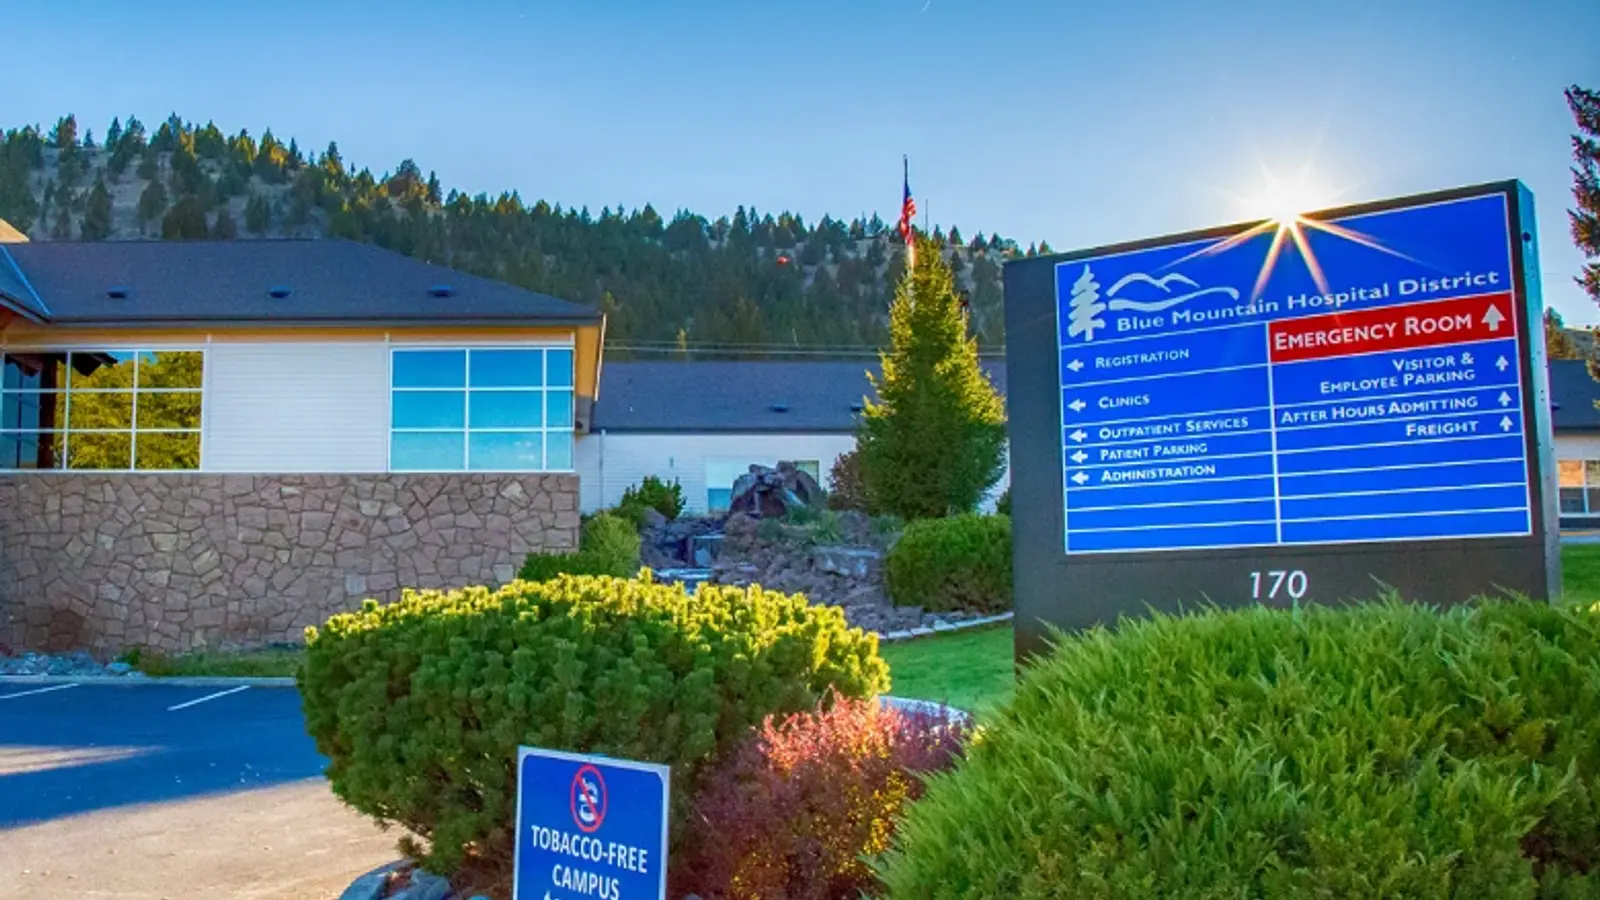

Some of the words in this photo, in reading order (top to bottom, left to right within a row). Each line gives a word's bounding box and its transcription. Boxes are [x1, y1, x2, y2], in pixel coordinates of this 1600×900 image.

[1117, 316, 1164, 332] Blue
[1172, 299, 1278, 325] Mountain
[1287, 282, 1389, 309] Hospital
[1399, 271, 1499, 295] District
[1274, 322, 1397, 350] EMERGENCY
[1404, 313, 1472, 336] ROOM
[1095, 348, 1189, 369] REGISTRATION
[1392, 355, 1455, 372] VISITOR
[1460, 351, 1474, 366] &
[1320, 376, 1398, 394] EMPLOYEE
[1403, 368, 1475, 386] PARKING
[1098, 394, 1150, 409] CLINICS
[1281, 410, 1328, 424] AFTER
[1331, 403, 1385, 419] HOURS
[1388, 396, 1478, 414] ADMITTING
[1099, 422, 1180, 440] OUTPATIENT
[1185, 416, 1248, 432] SERVICES
[1406, 420, 1478, 437] FREIGHT
[1100, 447, 1149, 461] PATIENT
[1153, 443, 1208, 457] PARKING
[1101, 464, 1216, 482] ADMINISTRATION
[1250, 570, 1308, 599] 170
[531, 824, 648, 874] TOBACCO-FREE
[552, 863, 620, 900] CAMPUS
